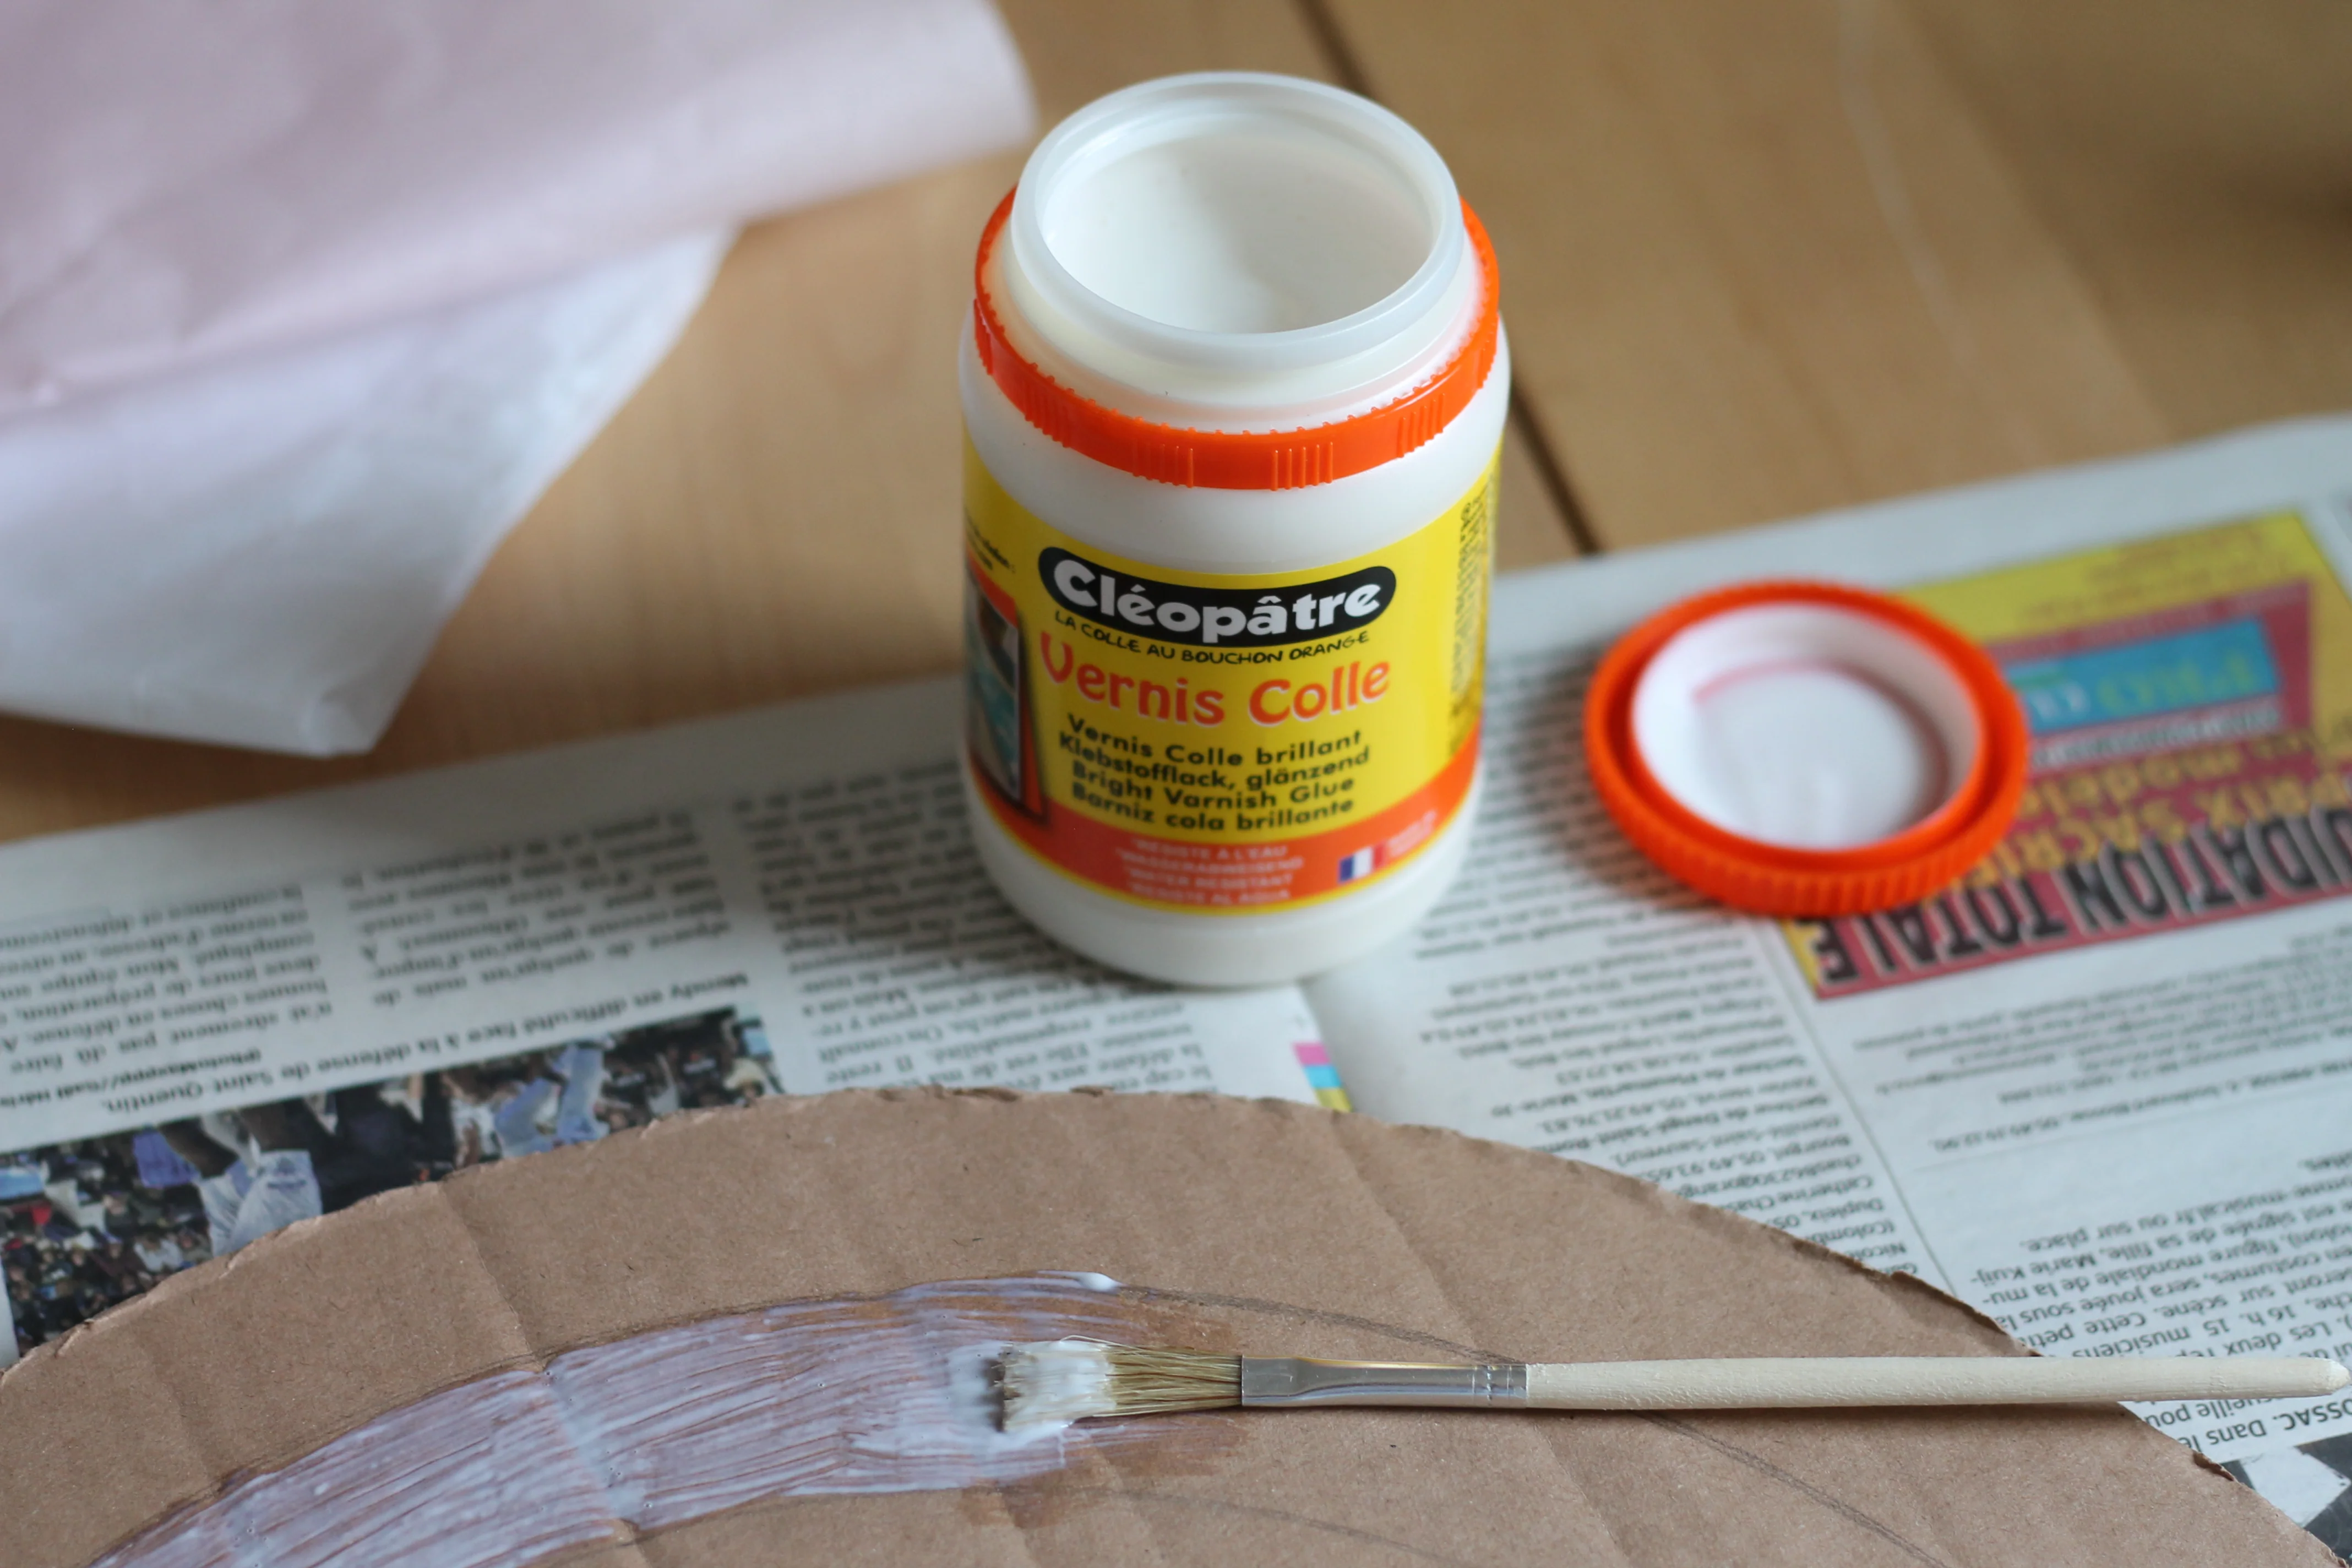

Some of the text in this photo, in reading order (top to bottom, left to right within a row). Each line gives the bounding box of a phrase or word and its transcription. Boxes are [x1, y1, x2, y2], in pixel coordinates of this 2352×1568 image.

[1053, 559, 1382, 643] Cléopâtre
[1055, 610, 1369, 665] LA COLLE AU BOUCHON ORANGE
[1039, 630, 1391, 727] Vernis Colle
[1068, 712, 1361, 766] Vernis Colle brillant
[1059, 731, 1369, 791] Klebstofflack, glänzend
[1072, 760, 1354, 810] Bright Varnish Glue
[1072, 781, 1354, 831] Barniz cola brillante
[523, 998, 628, 1036] difficulté
[468, 1021, 517, 1044] face
[213, 1070, 273, 1095] Saint
[280, 1061, 309, 1081] de
[101, 1081, 204, 1115] Quentin.
[1776, 1175, 1873, 1204] Catherine
[1804, 1220, 1895, 1247] (Colomb
[2019, 1226, 2089, 1254] place.
[1981, 1239, 2280, 1305] figure mondiale de la mu-
[2029, 1252, 2097, 1276] Marie
[2203, 1253, 2321, 1286] costumes,
[2079, 1284, 2147, 1314] jouée
[2149, 1277, 2201, 1298] sera
[2239, 1285, 2275, 1303] sur
[2019, 1302, 2075, 1325] sous
[2152, 1295, 2228, 1319] scène.
[2267, 1304, 2295, 1321] 16
[2083, 1312, 2146, 1335] Cette
[2203, 1318, 2230, 1336] 15
[2289, 1321, 2332, 1342] Les
[2072, 1326, 2191, 1357] musiciens
[2223, 1332, 2282, 1355] deux
[2206, 1419, 2267, 1446] Dans
